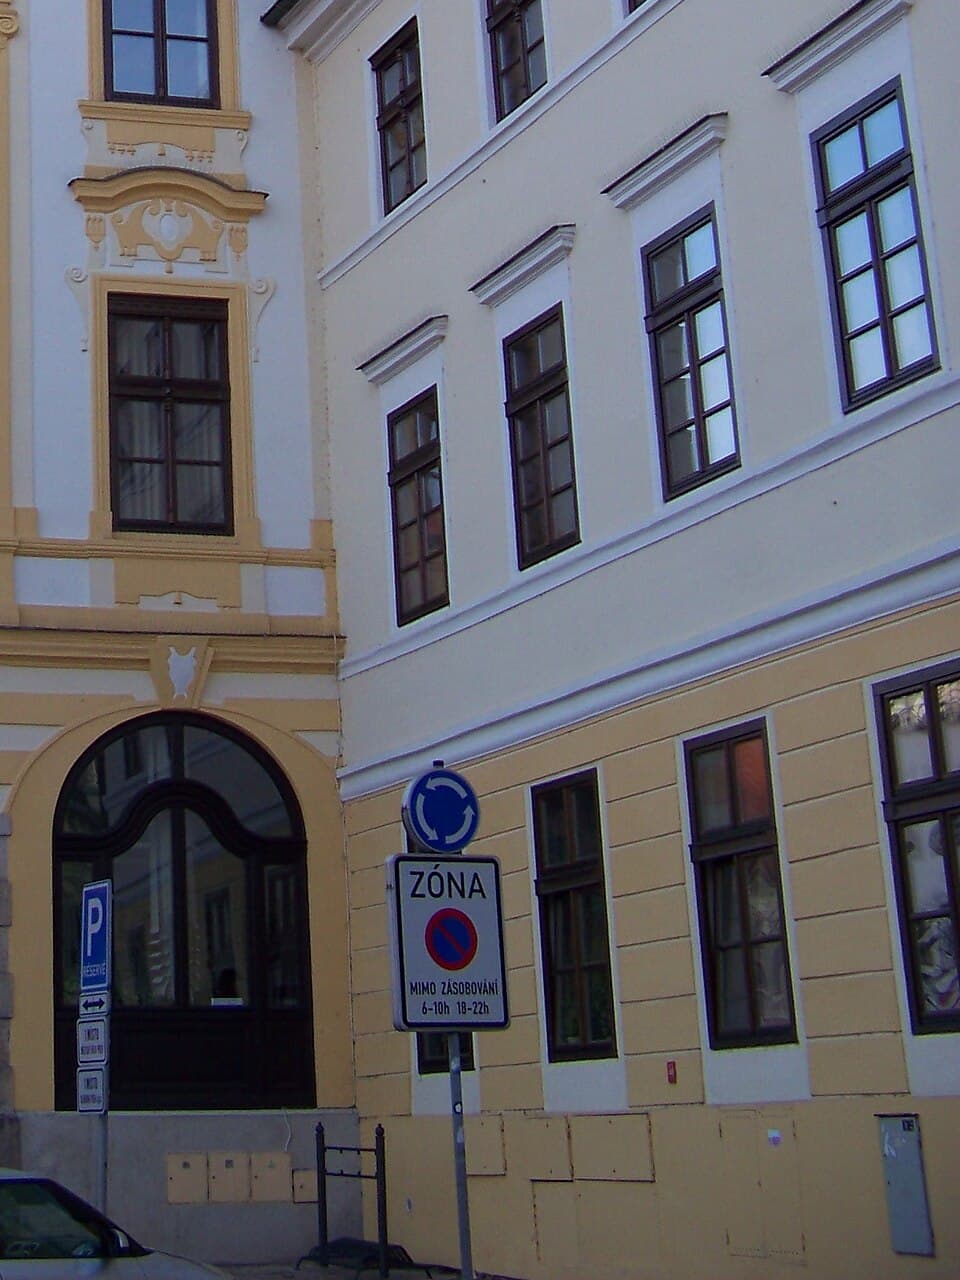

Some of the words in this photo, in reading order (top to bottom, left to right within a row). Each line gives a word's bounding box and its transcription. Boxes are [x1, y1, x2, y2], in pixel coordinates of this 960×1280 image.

[410, 864, 487, 899] ZÓNA
[87, 897, 102, 956] P
[410, 981, 437, 996] MIMO
[441, 977, 499, 996] ZÁSOBOVÁNÍ
[422, 1001, 450, 1015] 6-10h
[457, 1001, 490, 1015] 18-22h
